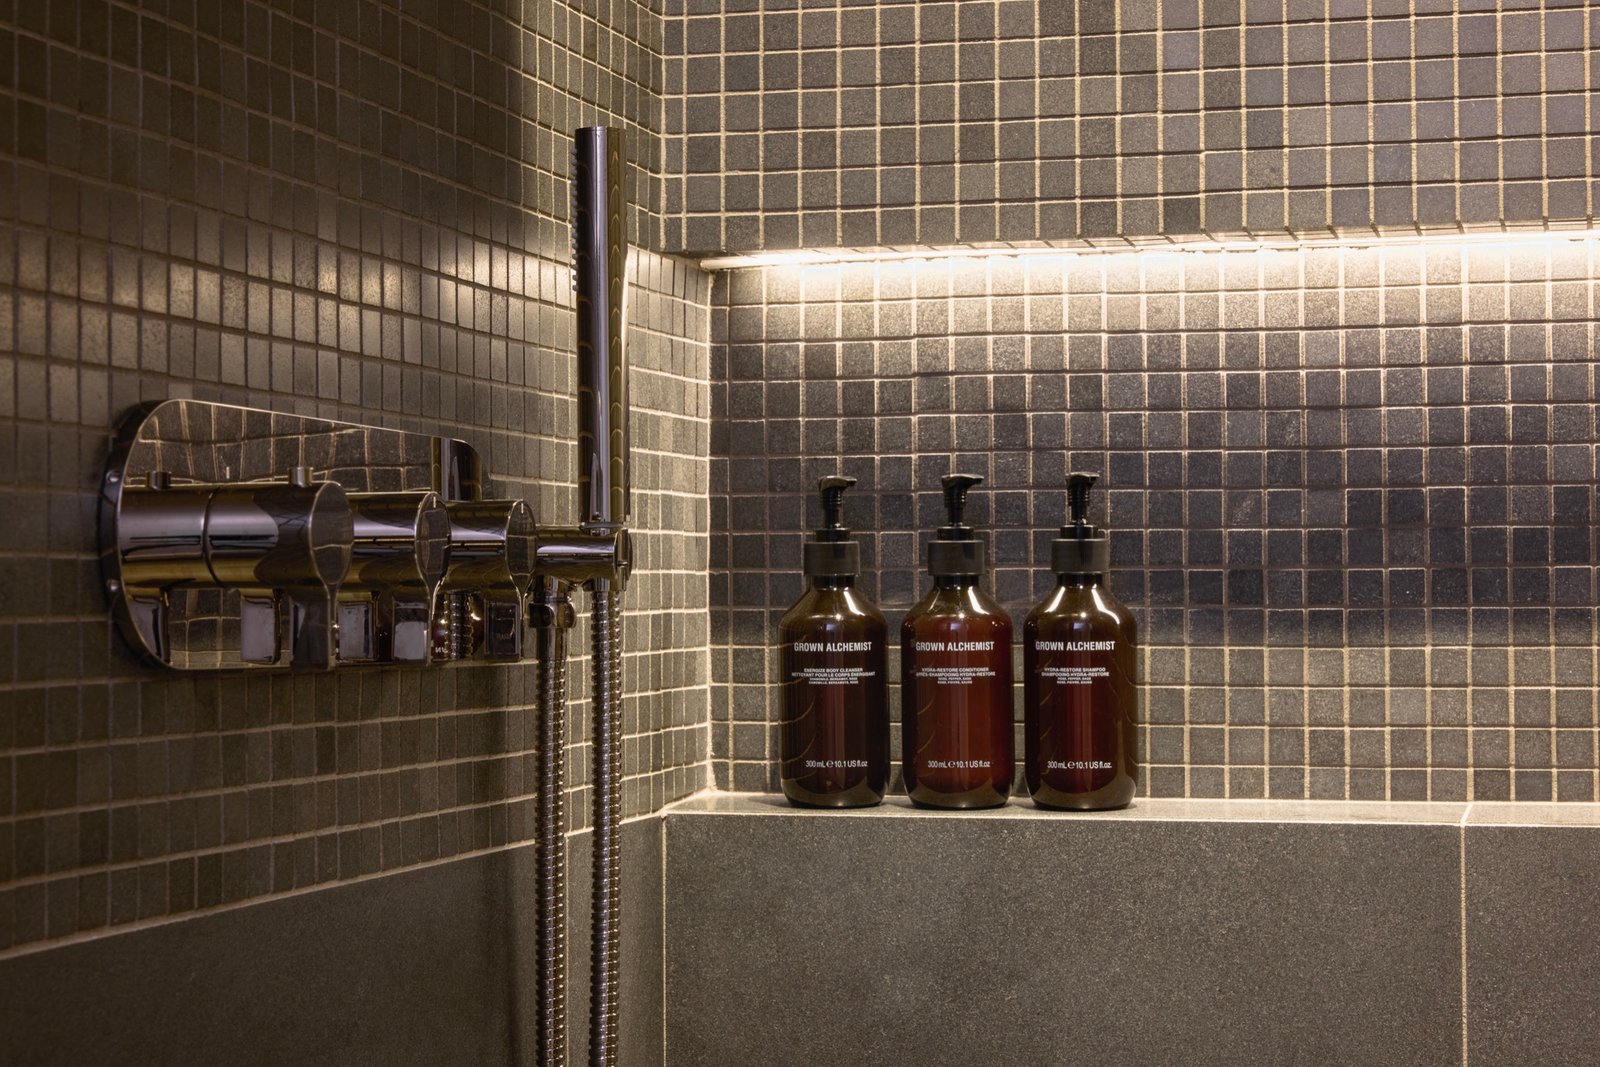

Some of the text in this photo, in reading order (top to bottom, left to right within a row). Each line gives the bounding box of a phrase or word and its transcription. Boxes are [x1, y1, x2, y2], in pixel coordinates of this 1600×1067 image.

[793, 641, 873, 652] GROWN ALCHEMIST
[915, 641, 995, 651] GROWN ALCHEMIST
[1035, 641, 1116, 651] GROWN ALCHEMIST
[834, 760, 847, 768] 10.1
[847, 759, 857, 768] US
[956, 760, 968, 768] 10.1
[969, 760, 979, 768] US
[1075, 761, 1088, 769] 10.1
[1088, 761, 1099, 769] US
